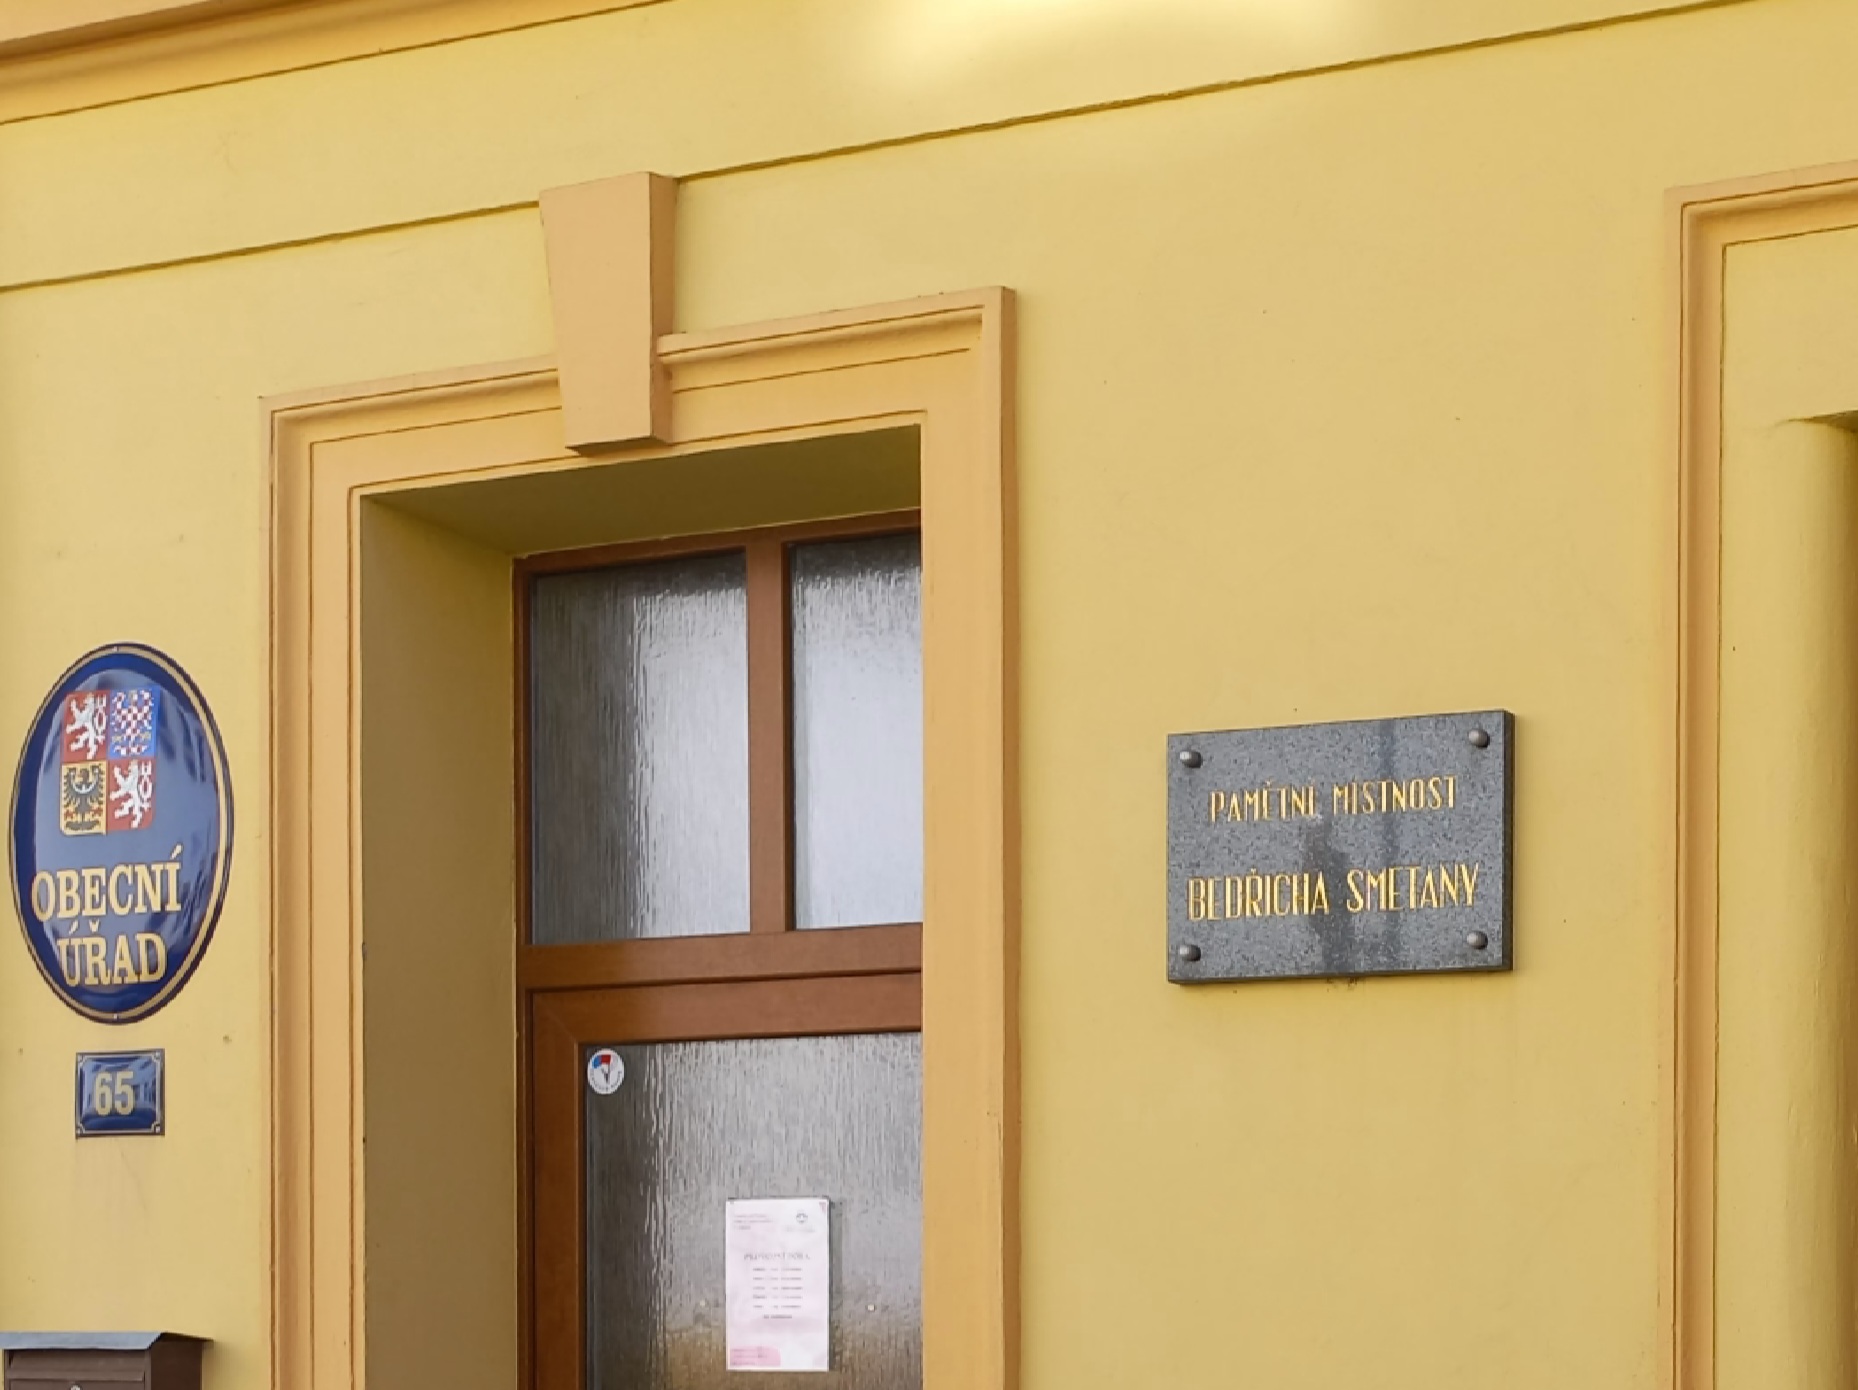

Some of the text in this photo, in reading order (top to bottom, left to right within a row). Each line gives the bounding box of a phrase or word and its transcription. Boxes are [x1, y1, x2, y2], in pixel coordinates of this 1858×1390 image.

[32, 844, 183, 923] OBECNÍ
[1188, 863, 1481, 921] BEDŘICHA SMETANY
[57, 919, 168, 987] ÚŘAD
[93, 1071, 136, 1116] 65
